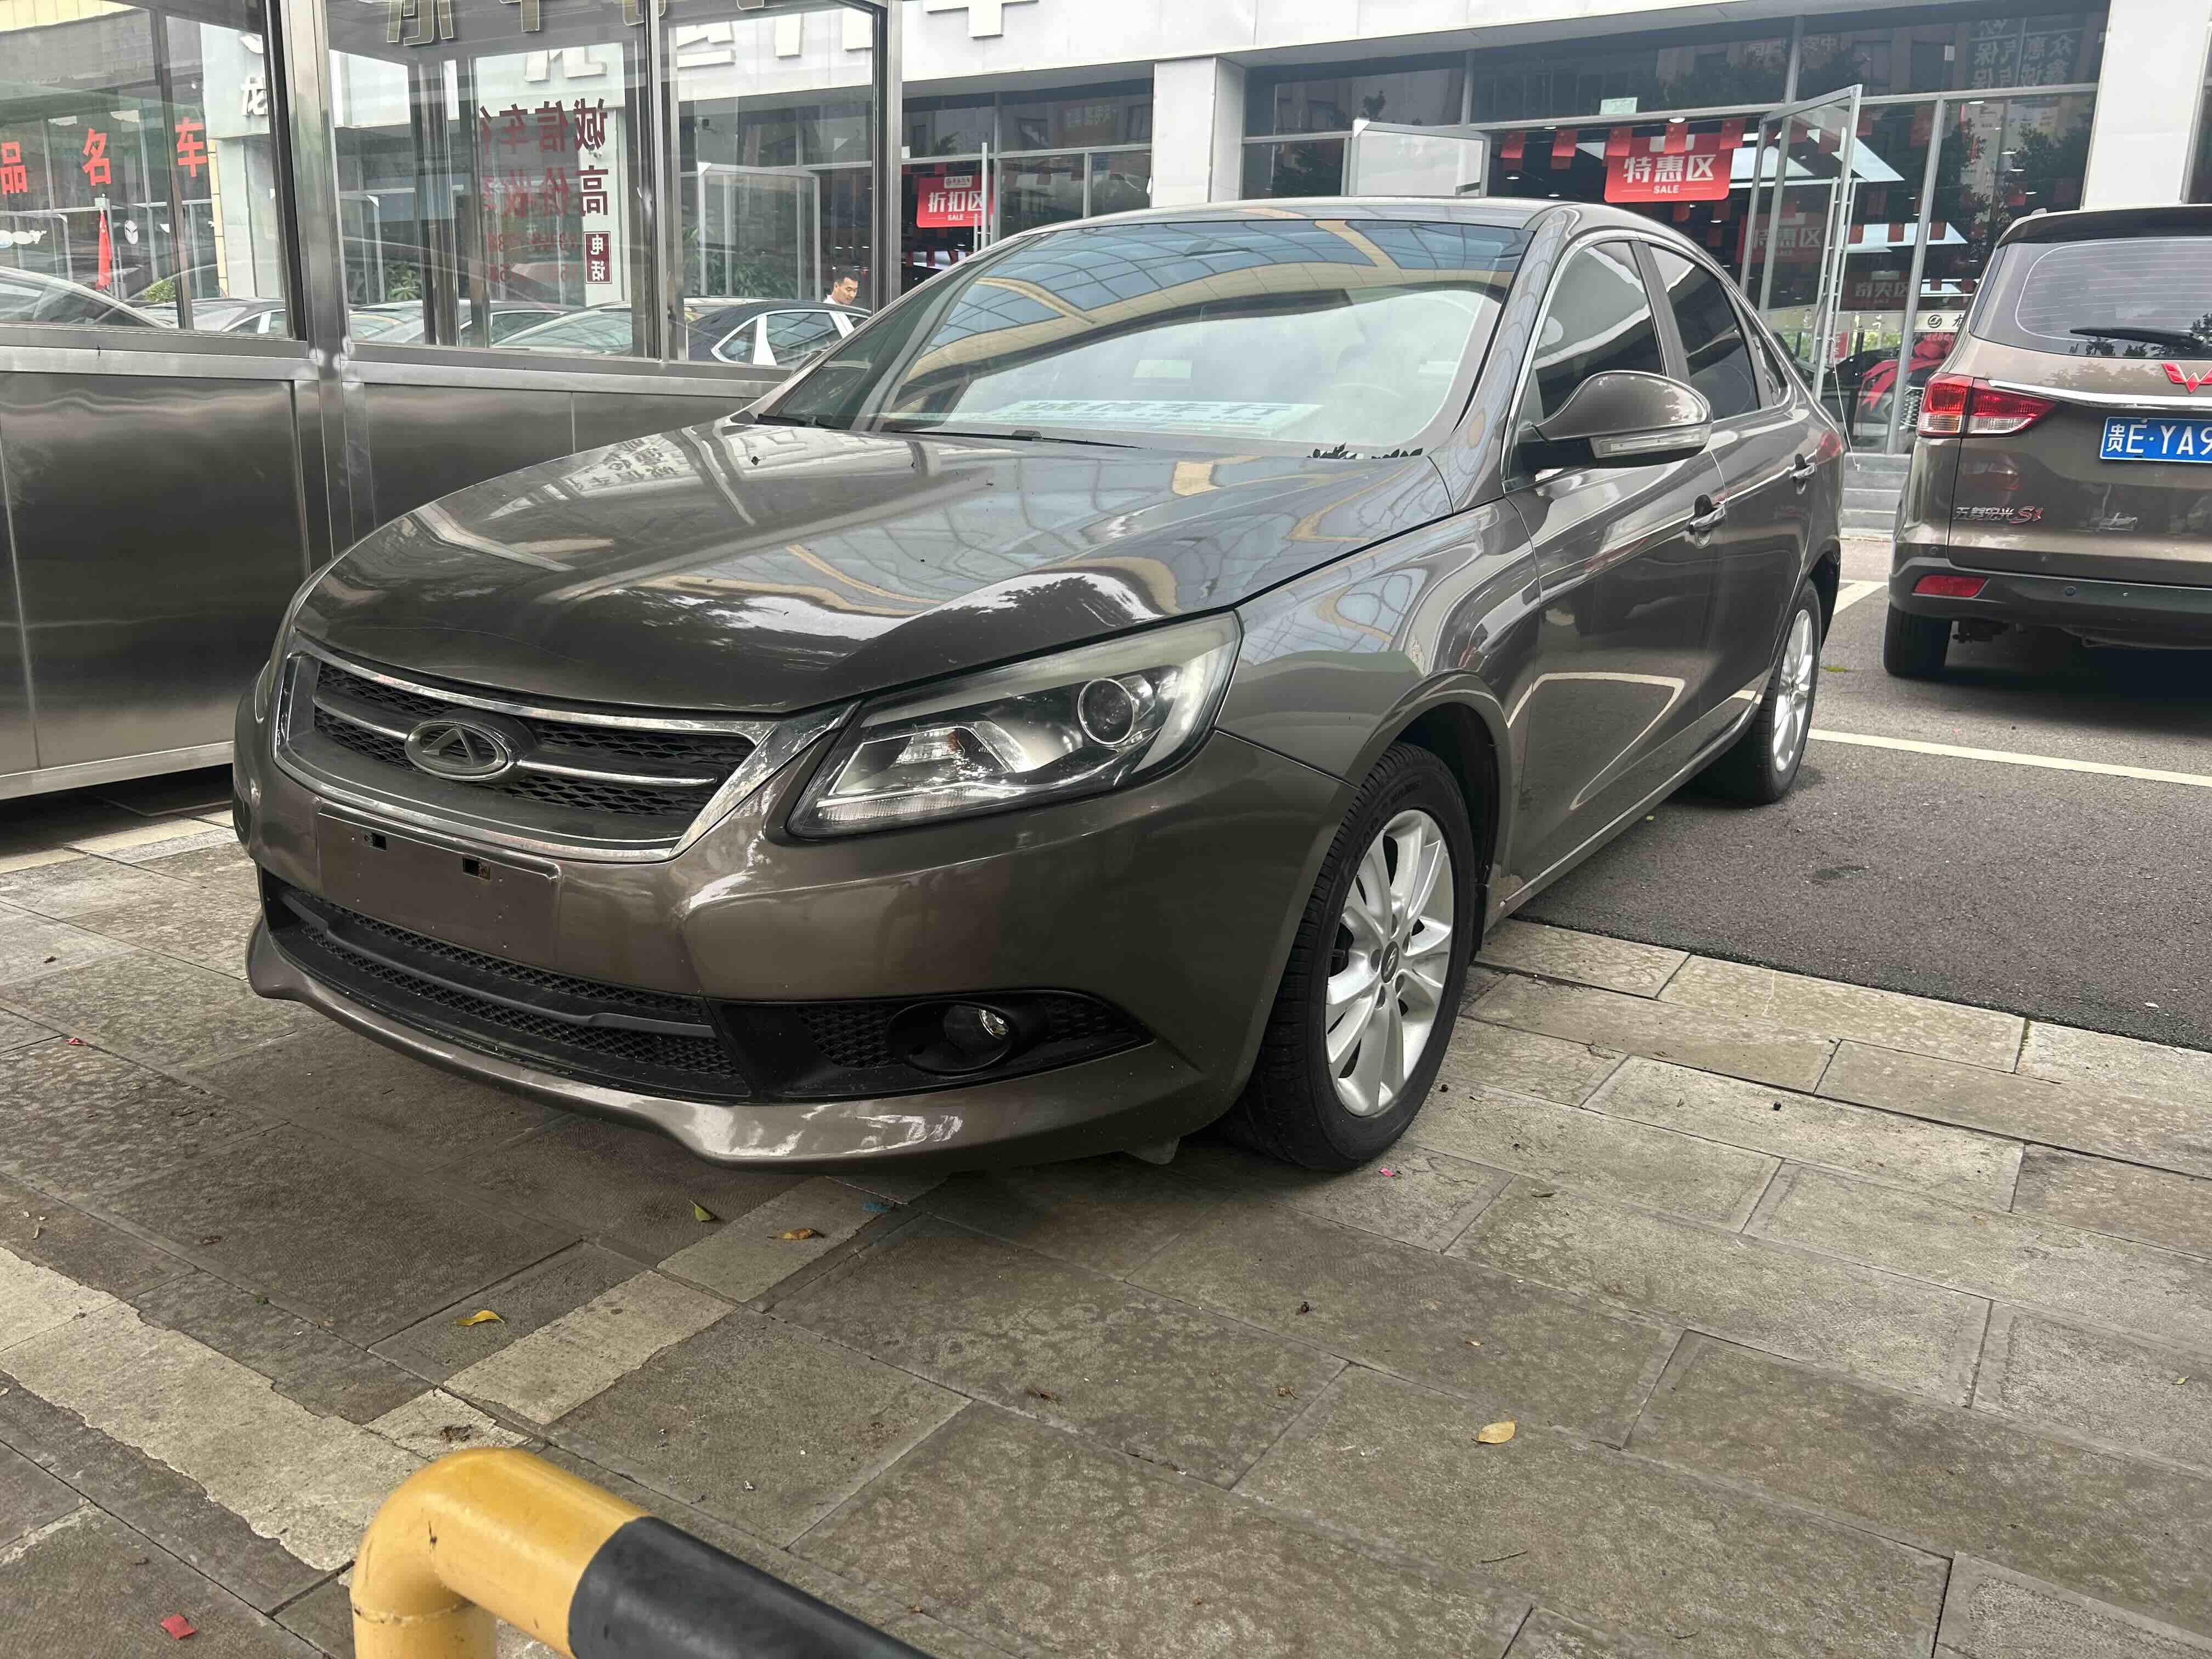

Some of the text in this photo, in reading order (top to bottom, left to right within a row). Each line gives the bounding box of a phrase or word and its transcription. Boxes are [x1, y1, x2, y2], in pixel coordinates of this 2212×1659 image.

[1623, 155, 1716, 184] 特惠区
[1653, 185, 1679, 194] SALE
[928, 191, 983, 213] 折扣区
